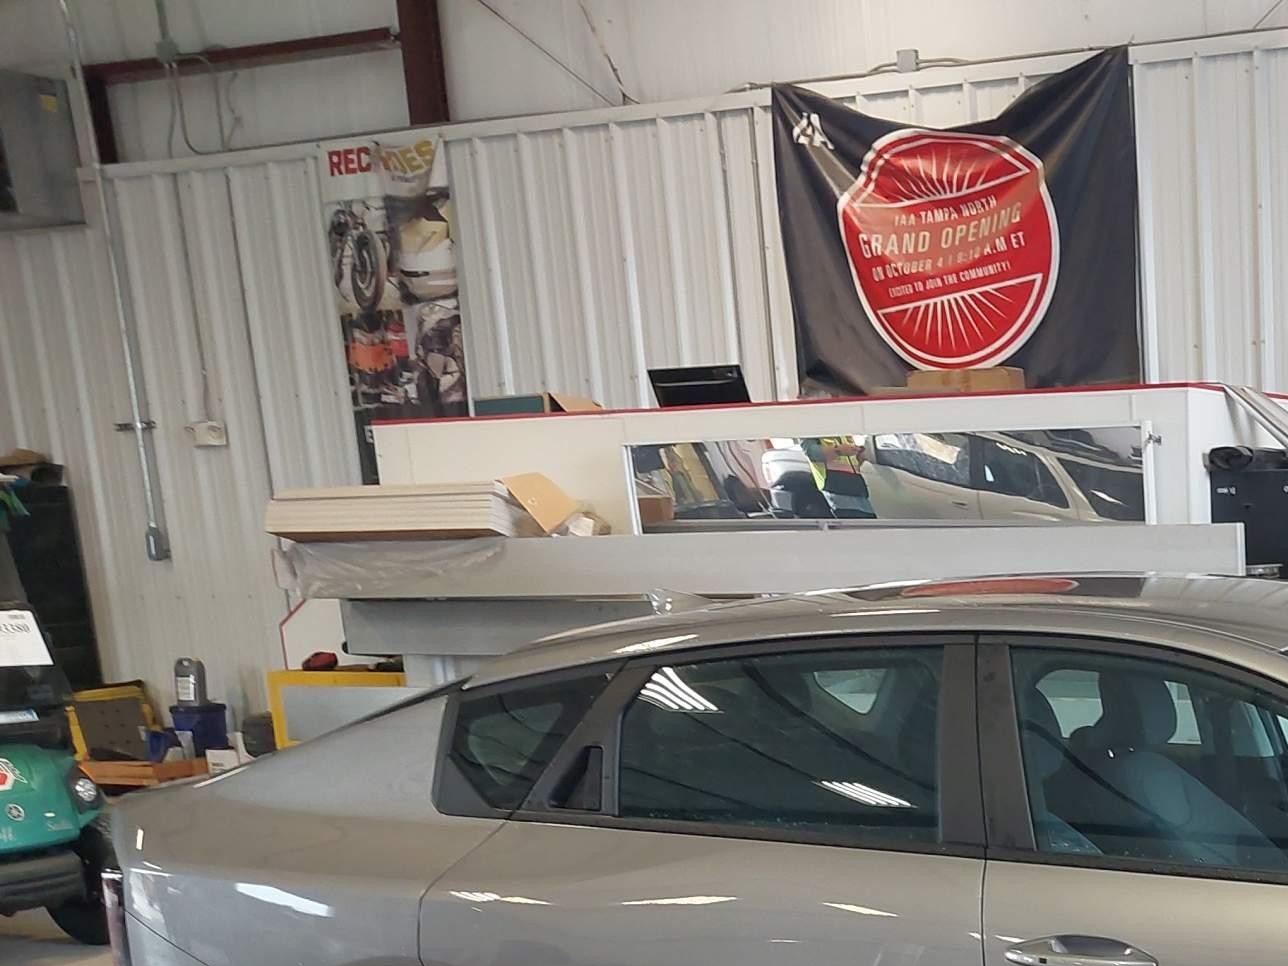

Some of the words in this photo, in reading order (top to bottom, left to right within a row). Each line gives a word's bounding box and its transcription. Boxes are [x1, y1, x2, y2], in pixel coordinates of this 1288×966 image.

[327, 146, 371, 176] REC
[895, 213, 916, 226] IAA
[920, 207, 958, 224] TAMPA
[960, 195, 996, 216] NORTH
[858, 231, 930, 258] GRAND
[942, 202, 1021, 248] OPENING
[885, 258, 932, 279] OCTOBER
[1010, 232, 1025, 248] ET
[943, 273, 958, 286] THE
